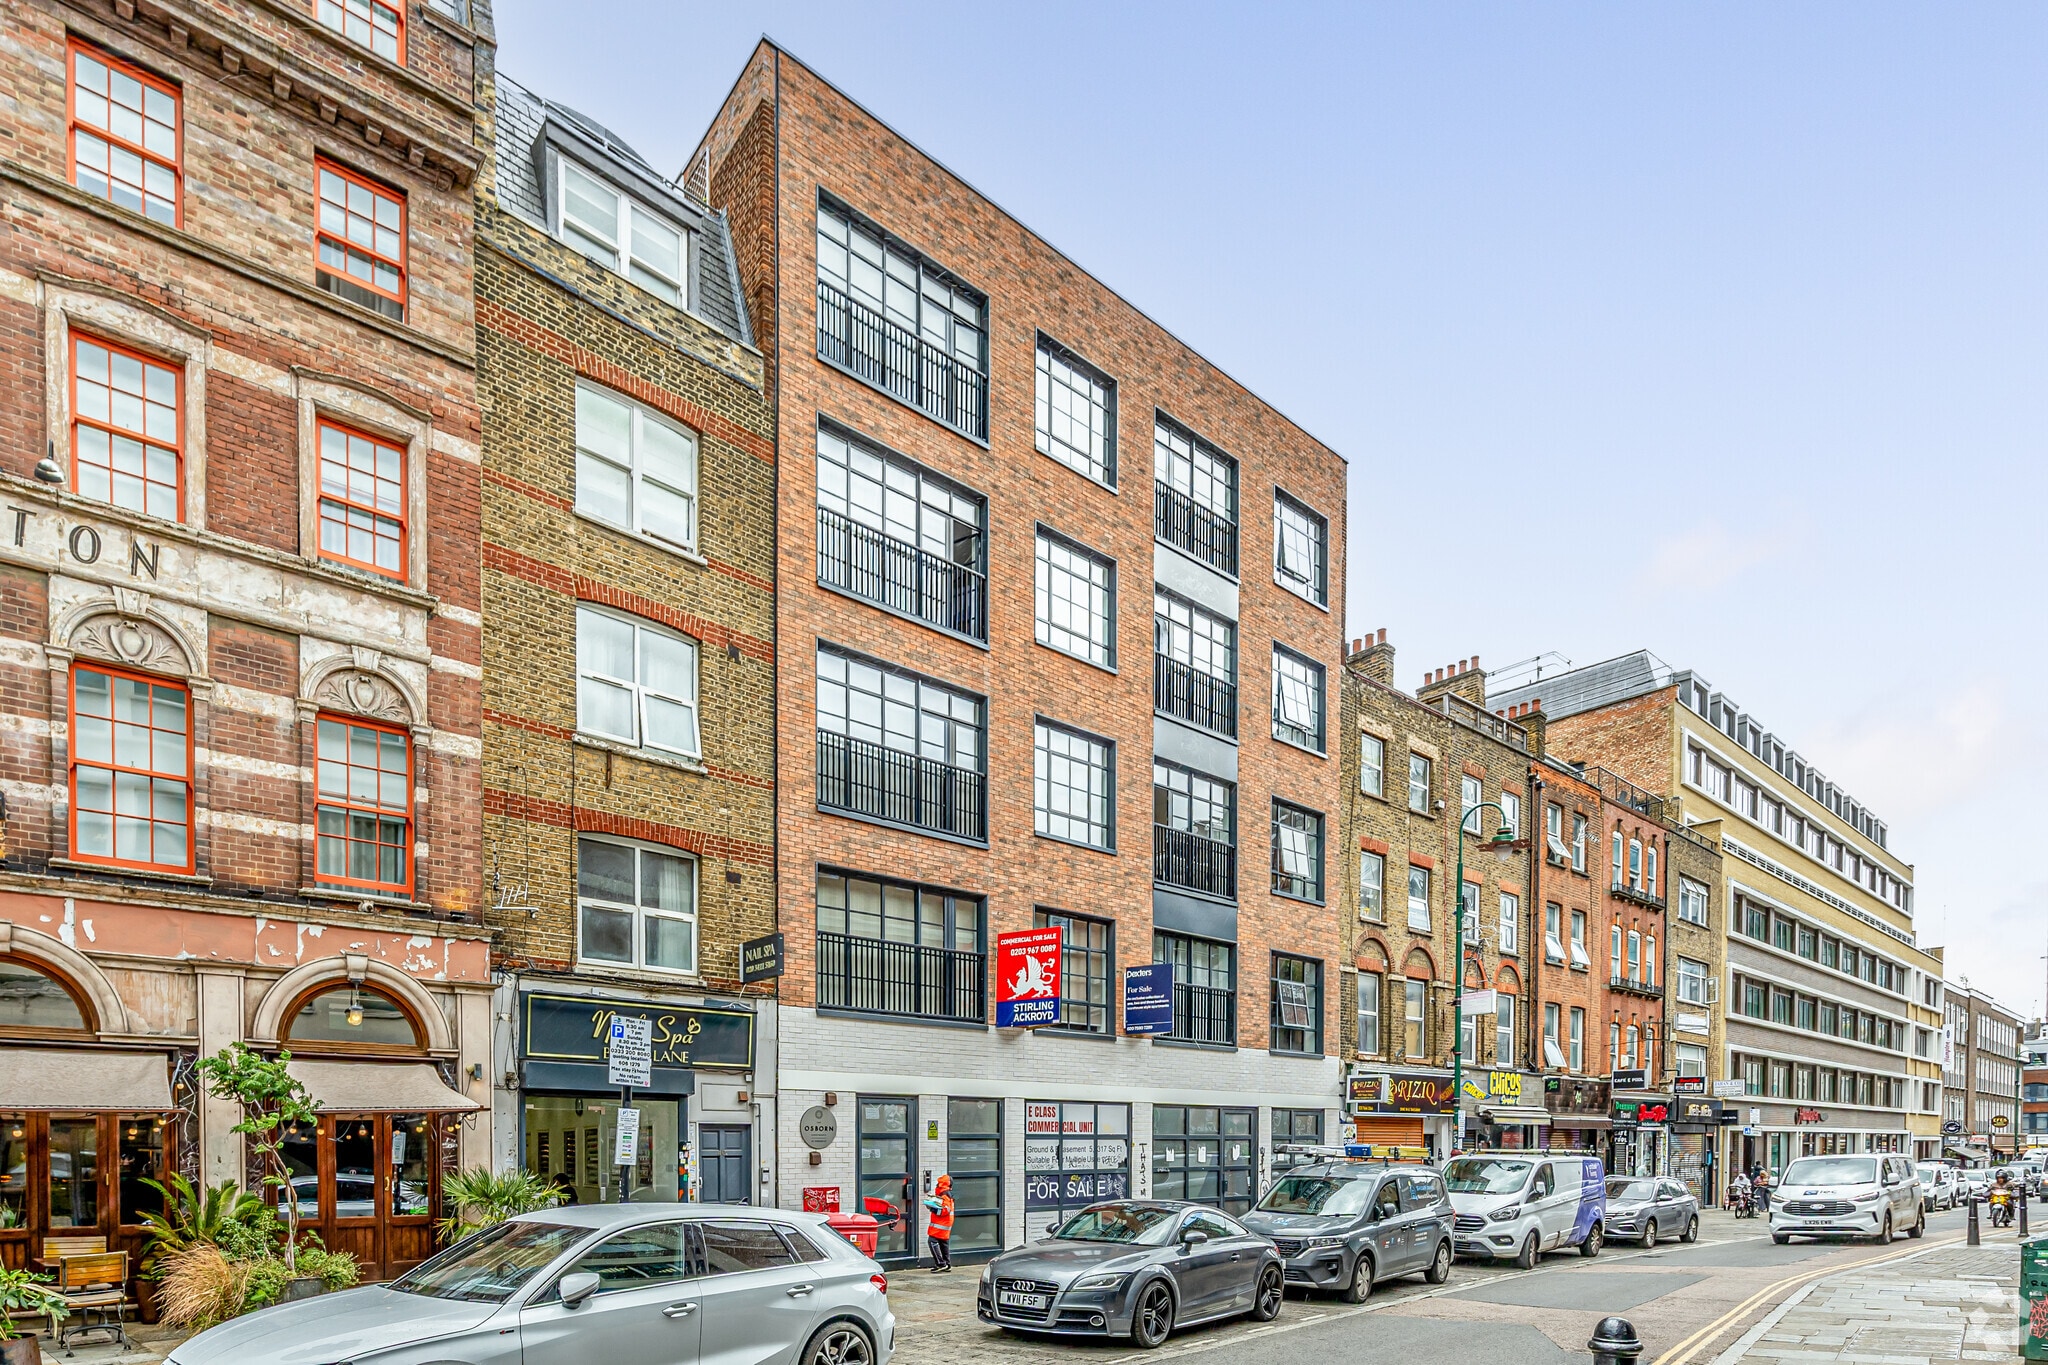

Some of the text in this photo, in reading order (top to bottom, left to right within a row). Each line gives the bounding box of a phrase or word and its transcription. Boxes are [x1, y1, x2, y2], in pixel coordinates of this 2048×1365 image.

[1001, 937, 1032, 945] COMMERCIAL
[745, 943, 775, 962] NAIL SPA
[1010, 944, 1056, 956] 0203 967 0089
[1127, 969, 1152, 978] Dexters
[1014, 1001, 1054, 1012] STIRLING
[1013, 1011, 1054, 1022] ACKROYD
[614, 1026, 623, 1037] P
[652, 1015, 695, 1050] Spa
[654, 1050, 689, 1064] LANE
[1028, 1106, 1056, 1118] E CLASS
[1028, 1121, 1093, 1133] COMMERCIAL UNIT
[1108, 1145, 1116, 1153] Sq
[1027, 1180, 1106, 1200] FOR SALE
[1023, 1295, 1039, 1306] FSF
